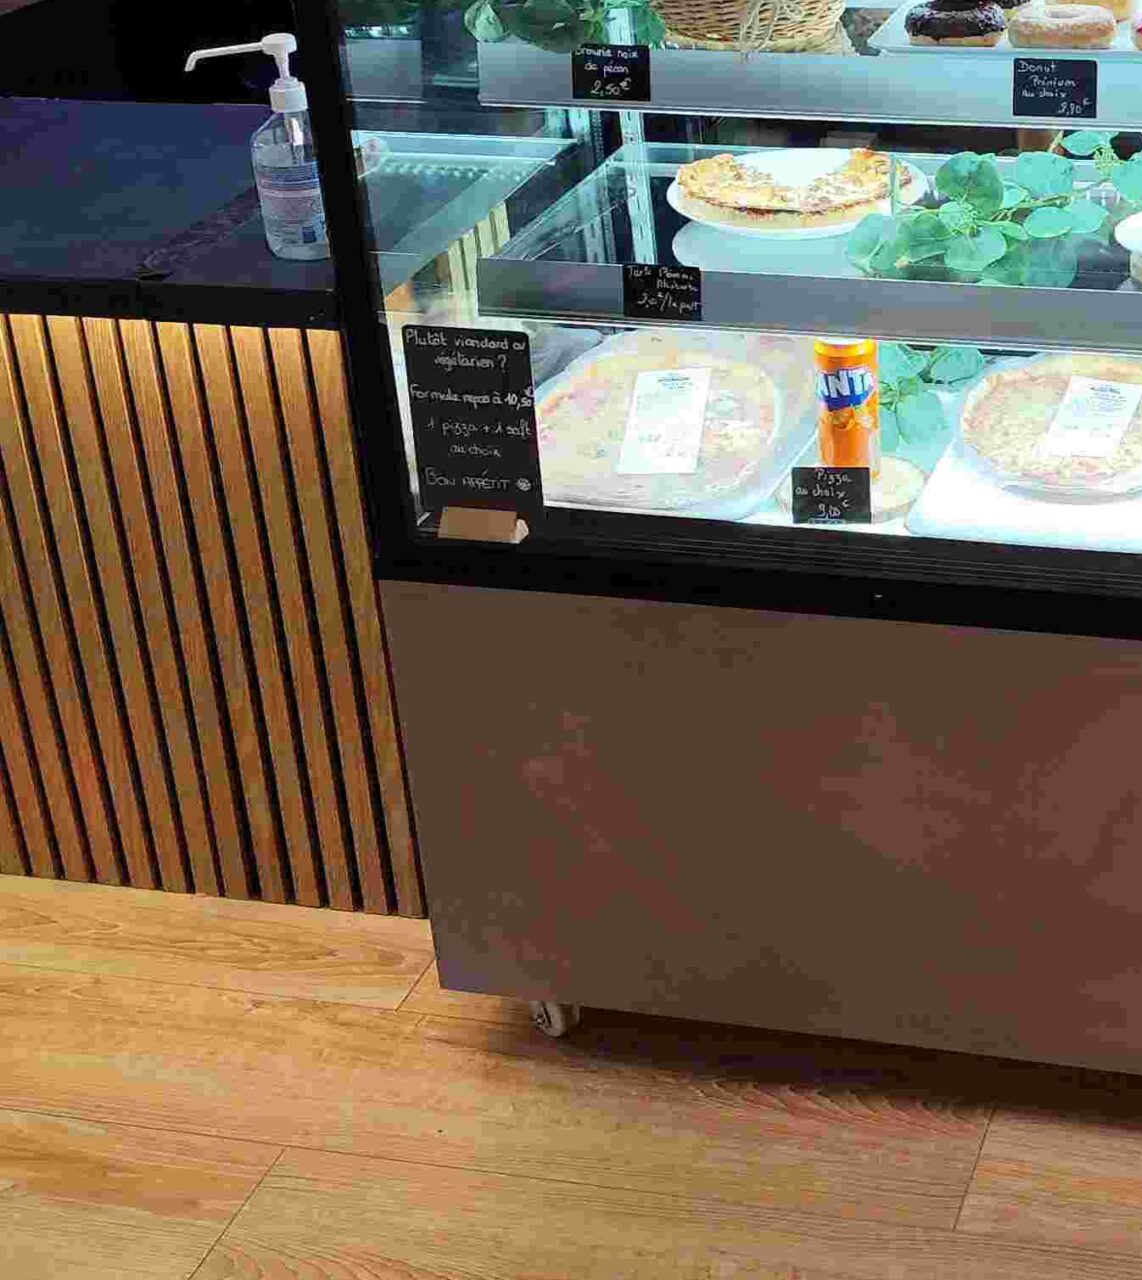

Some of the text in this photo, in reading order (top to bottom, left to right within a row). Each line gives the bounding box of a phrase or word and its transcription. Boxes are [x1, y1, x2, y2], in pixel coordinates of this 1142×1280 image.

[1017, 60, 1058, 73] Donut
[405, 327, 448, 347] Plutôt
[454, 335, 509, 351] viandard
[409, 382, 462, 404] Formule
[814, 468, 853, 485] Pizza
